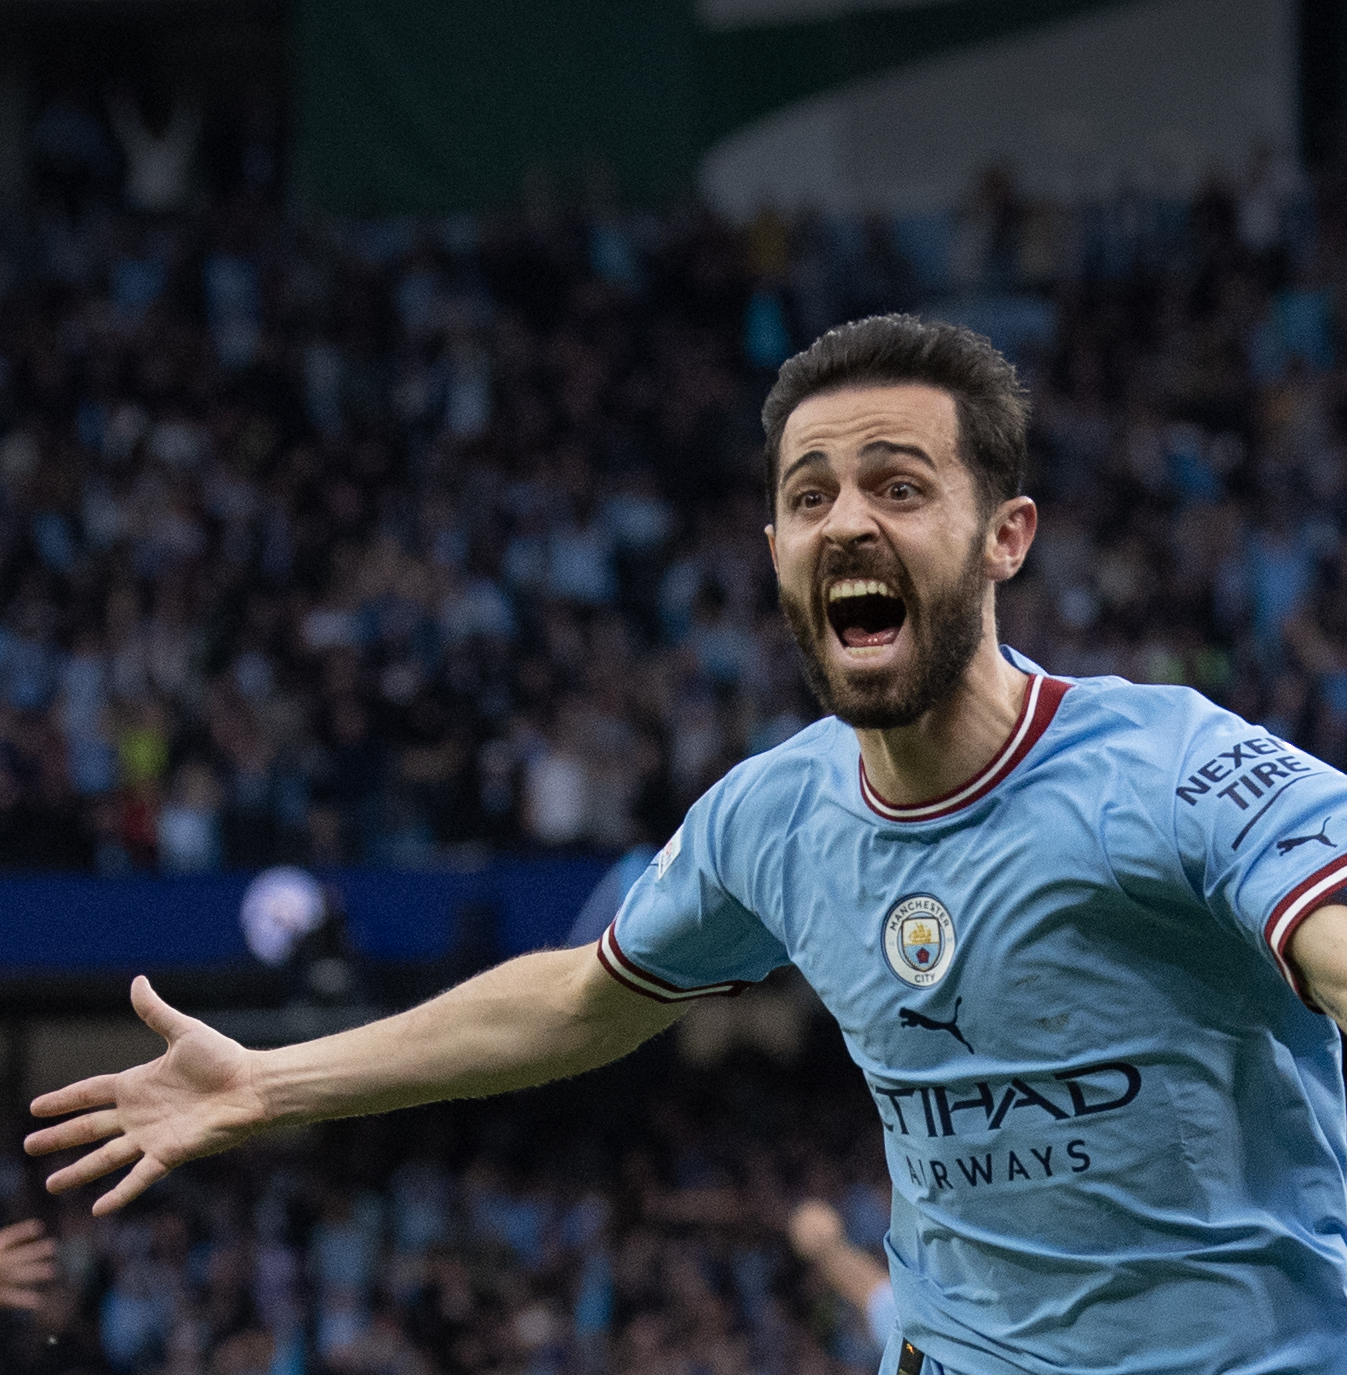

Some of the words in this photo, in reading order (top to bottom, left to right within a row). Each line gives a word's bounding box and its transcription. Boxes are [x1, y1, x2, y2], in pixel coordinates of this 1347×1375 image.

[1216, 755, 1311, 811] TIRE
[890, 900, 950, 932] MANCHESTER
[914, 972, 936, 984] CITY
[869, 1061, 1142, 1138] TIHAD
[906, 1139, 1091, 1190] AIRWAYS
